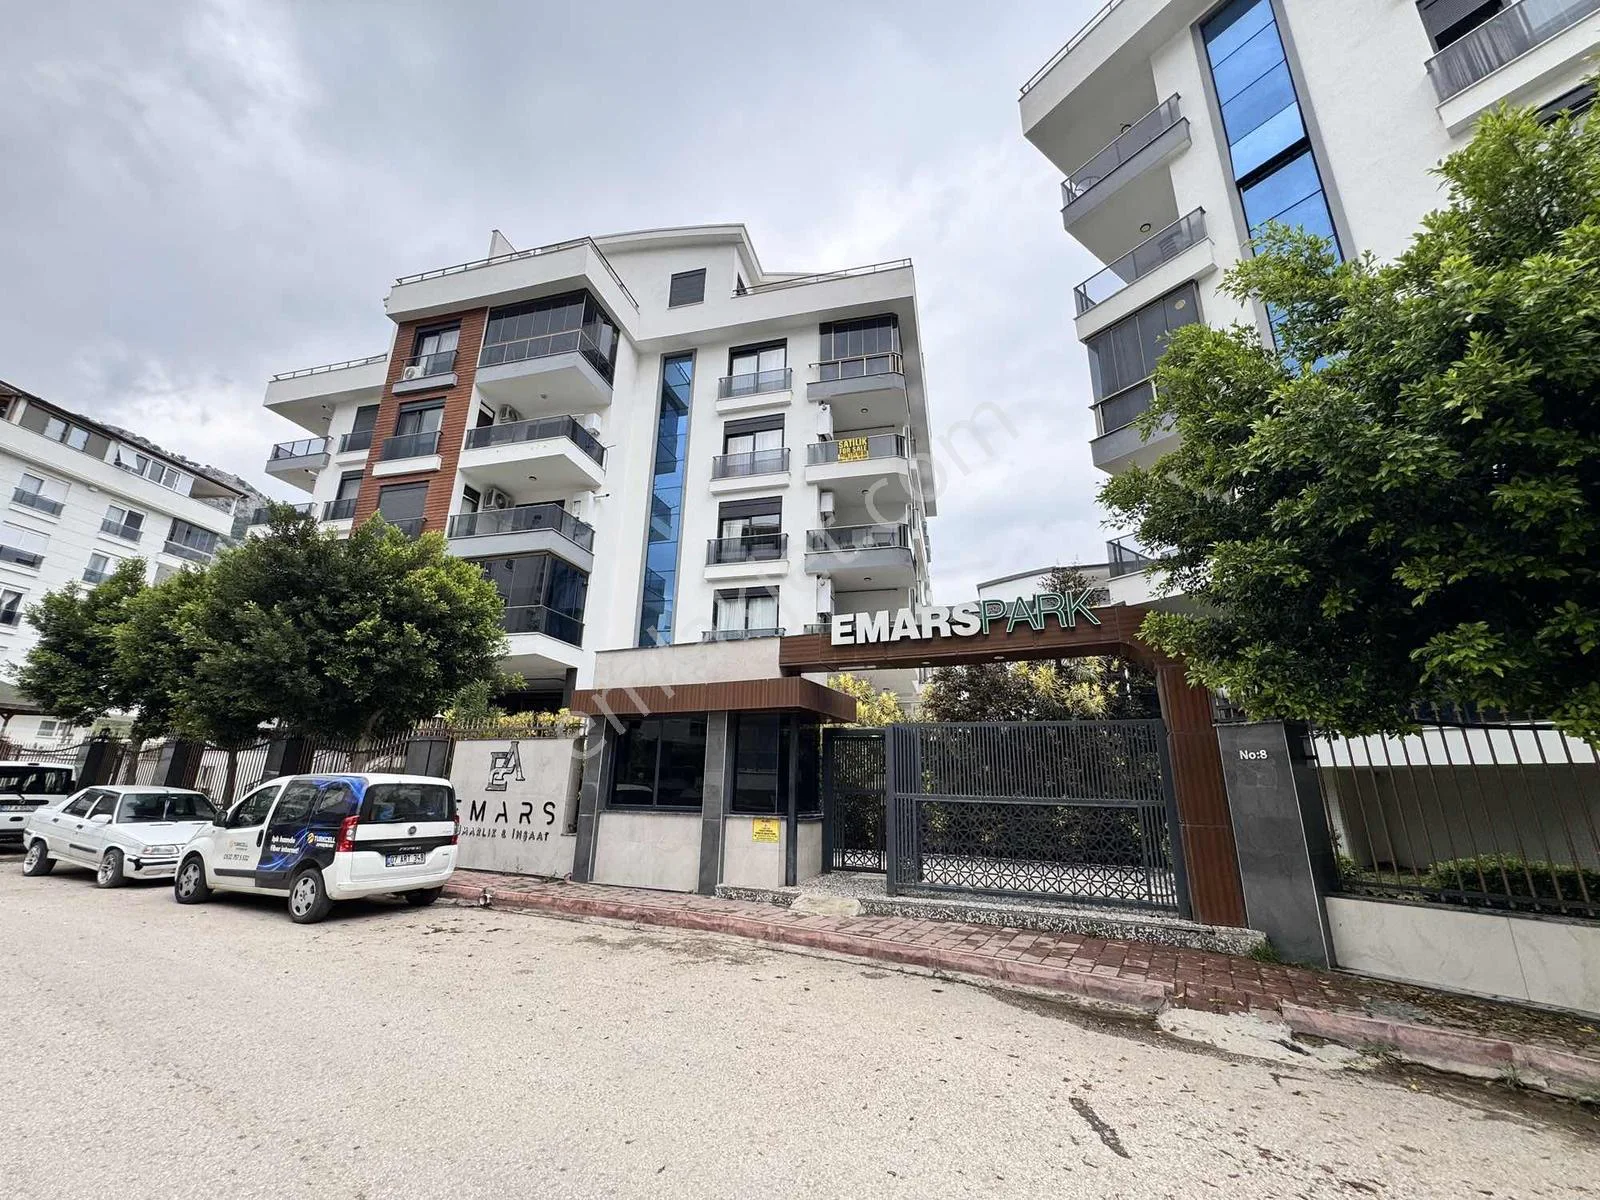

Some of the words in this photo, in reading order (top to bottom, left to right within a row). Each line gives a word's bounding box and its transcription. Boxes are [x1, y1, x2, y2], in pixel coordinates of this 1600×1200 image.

[839, 437, 867, 448] SATILIK
[1239, 749, 1268, 760] No:8
[456, 800, 556, 825] MARS
